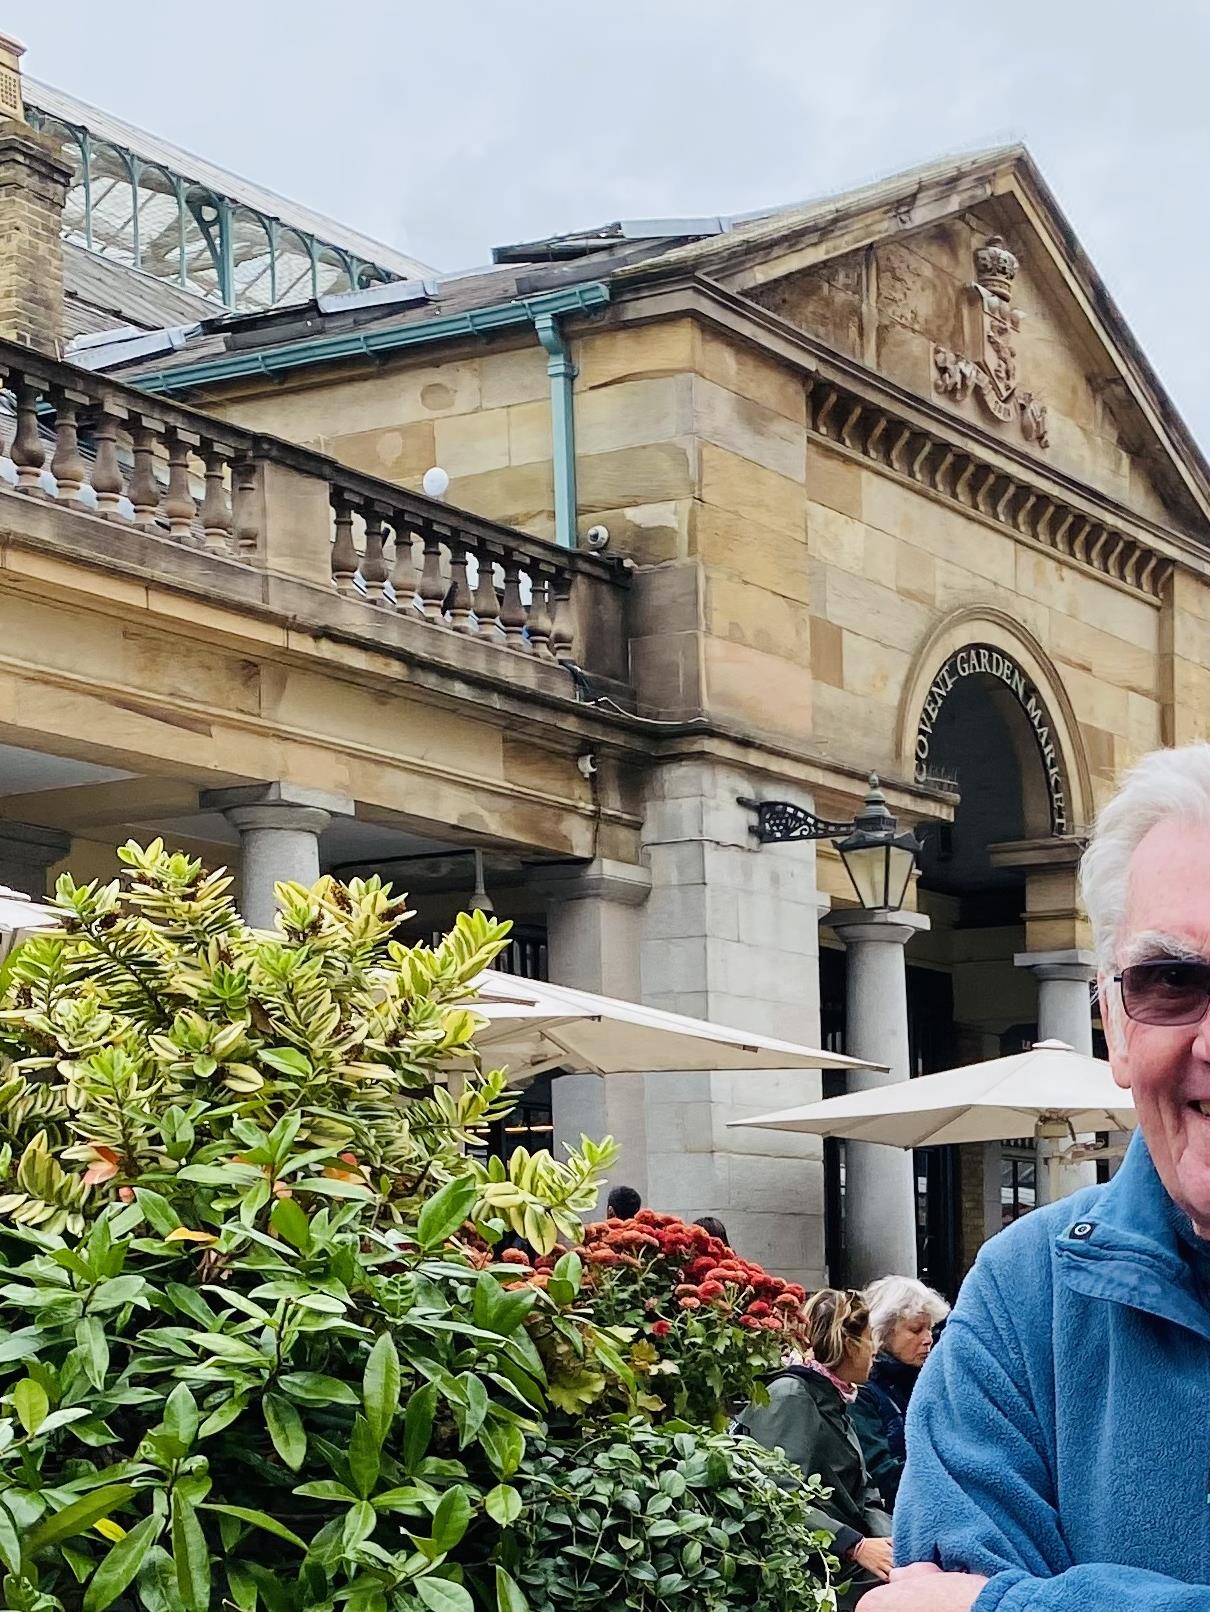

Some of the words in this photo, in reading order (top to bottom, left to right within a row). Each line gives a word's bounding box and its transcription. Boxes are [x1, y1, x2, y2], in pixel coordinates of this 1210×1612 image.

[914, 660, 954, 783] COVENT
[956, 648, 1025, 700] GARDEN
[1026, 696, 1067, 833] MARKET
